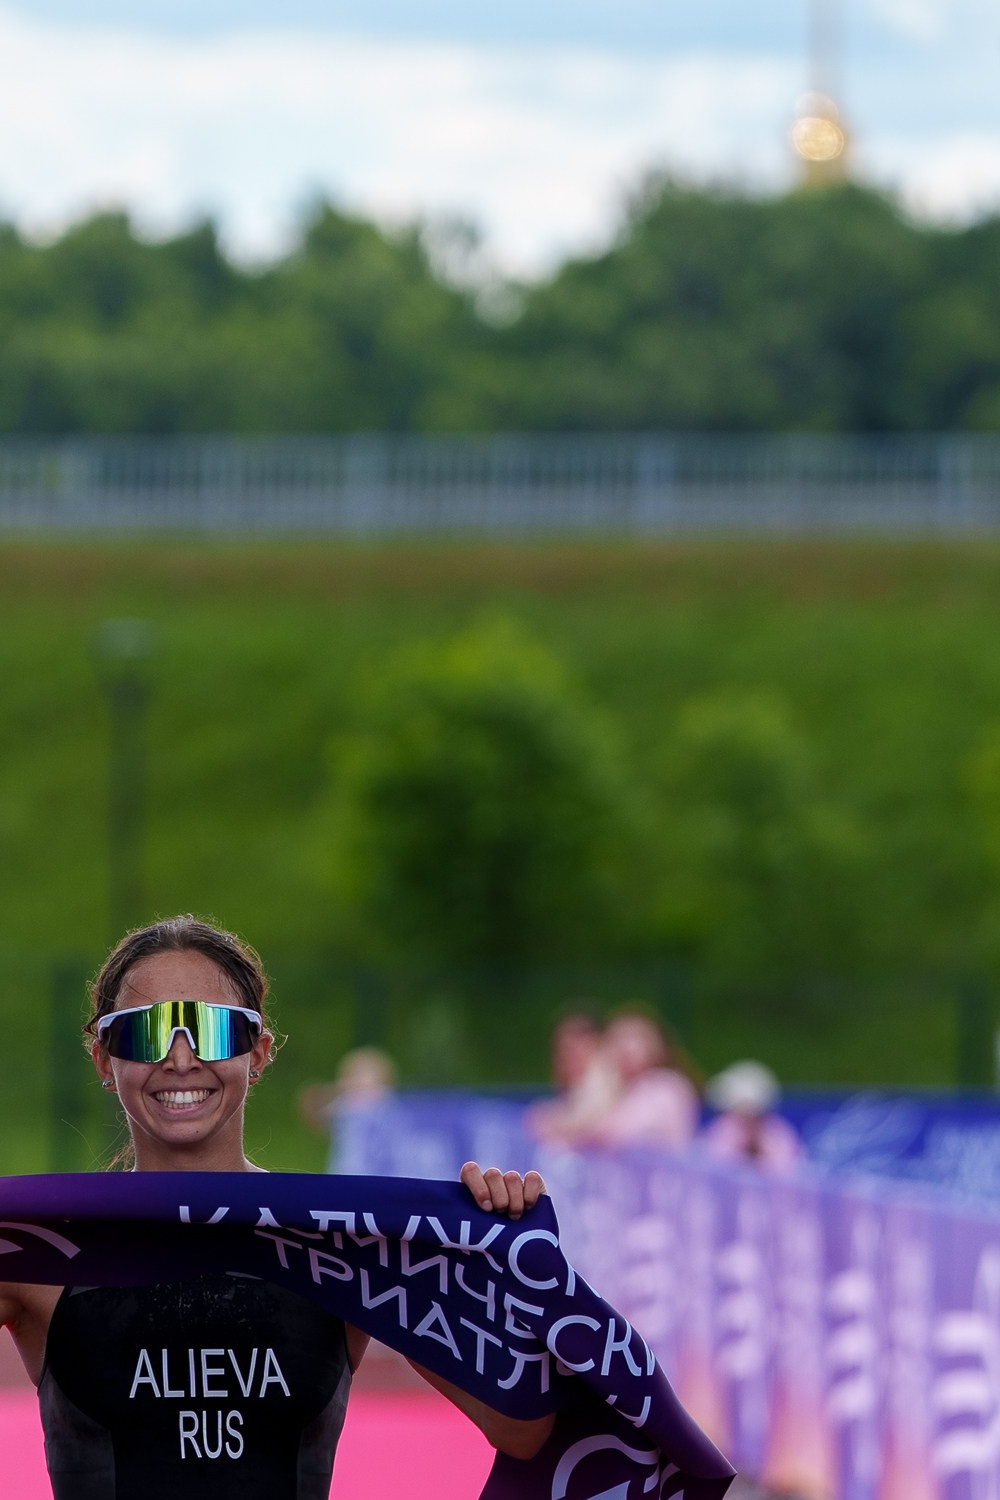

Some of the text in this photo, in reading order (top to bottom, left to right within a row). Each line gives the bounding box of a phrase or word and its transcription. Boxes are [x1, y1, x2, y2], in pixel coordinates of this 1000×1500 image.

[254, 1229, 576, 1394] ТРИАТЛ
[129, 1348, 291, 1399] ALIEVA
[178, 1410, 245, 1460] RUS
